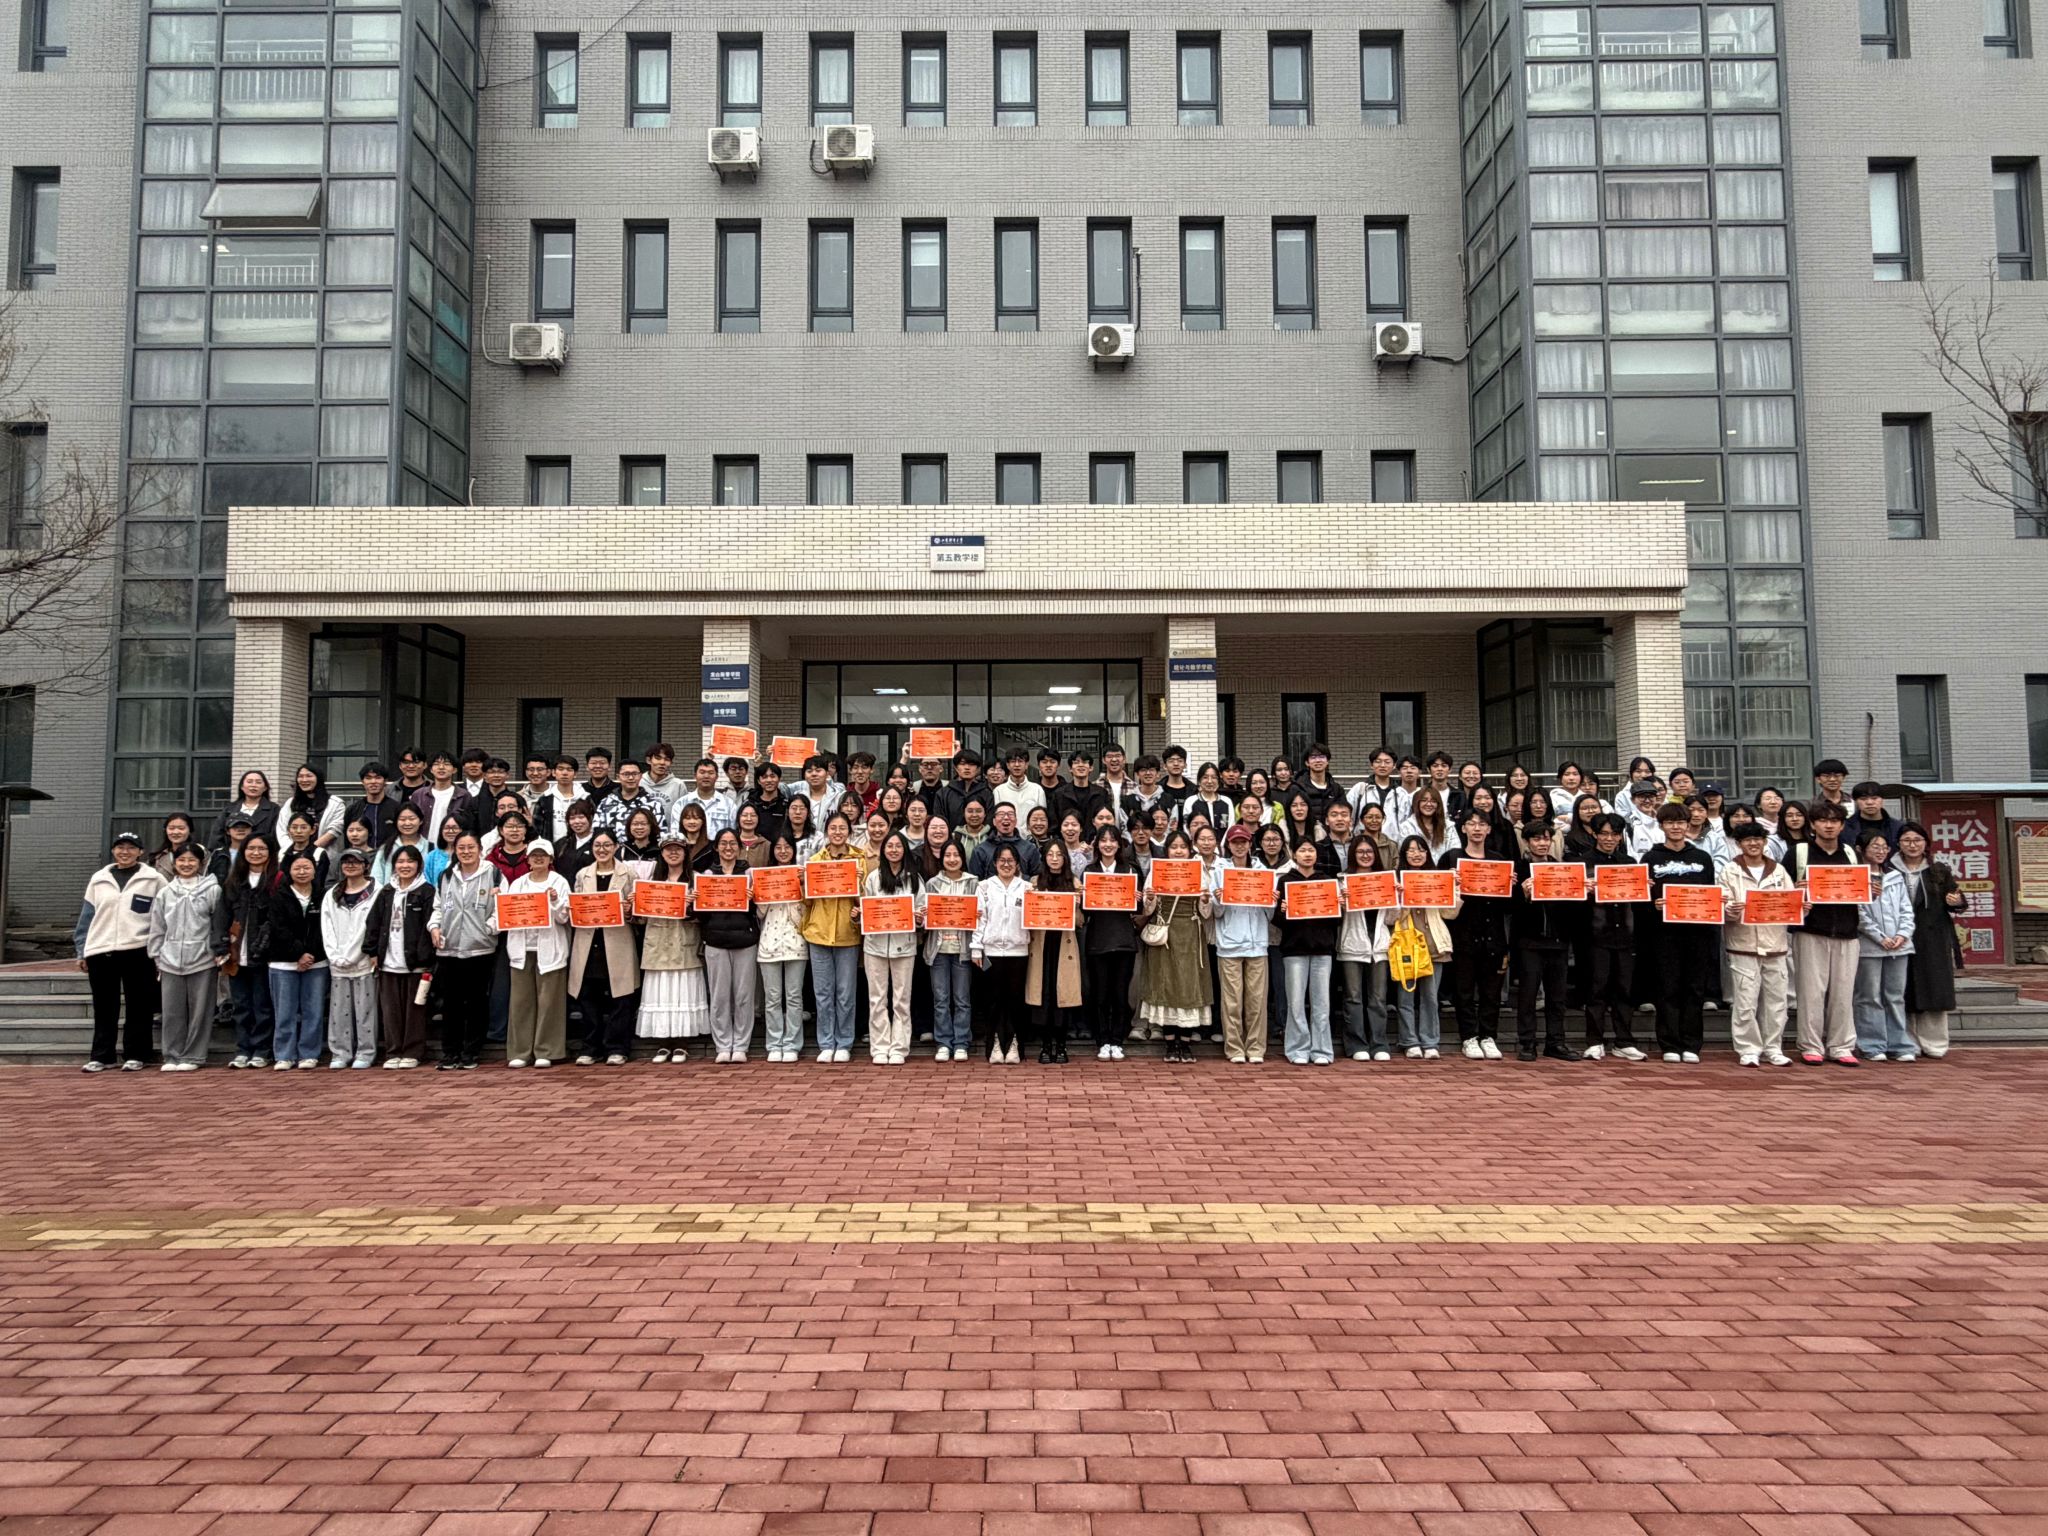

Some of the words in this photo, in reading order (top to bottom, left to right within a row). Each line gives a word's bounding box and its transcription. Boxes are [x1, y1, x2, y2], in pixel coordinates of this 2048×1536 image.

[936, 553, 979, 562] 第五教学楼
[1931, 818, 1989, 849] 中公
[1933, 850, 1991, 880] 教育
